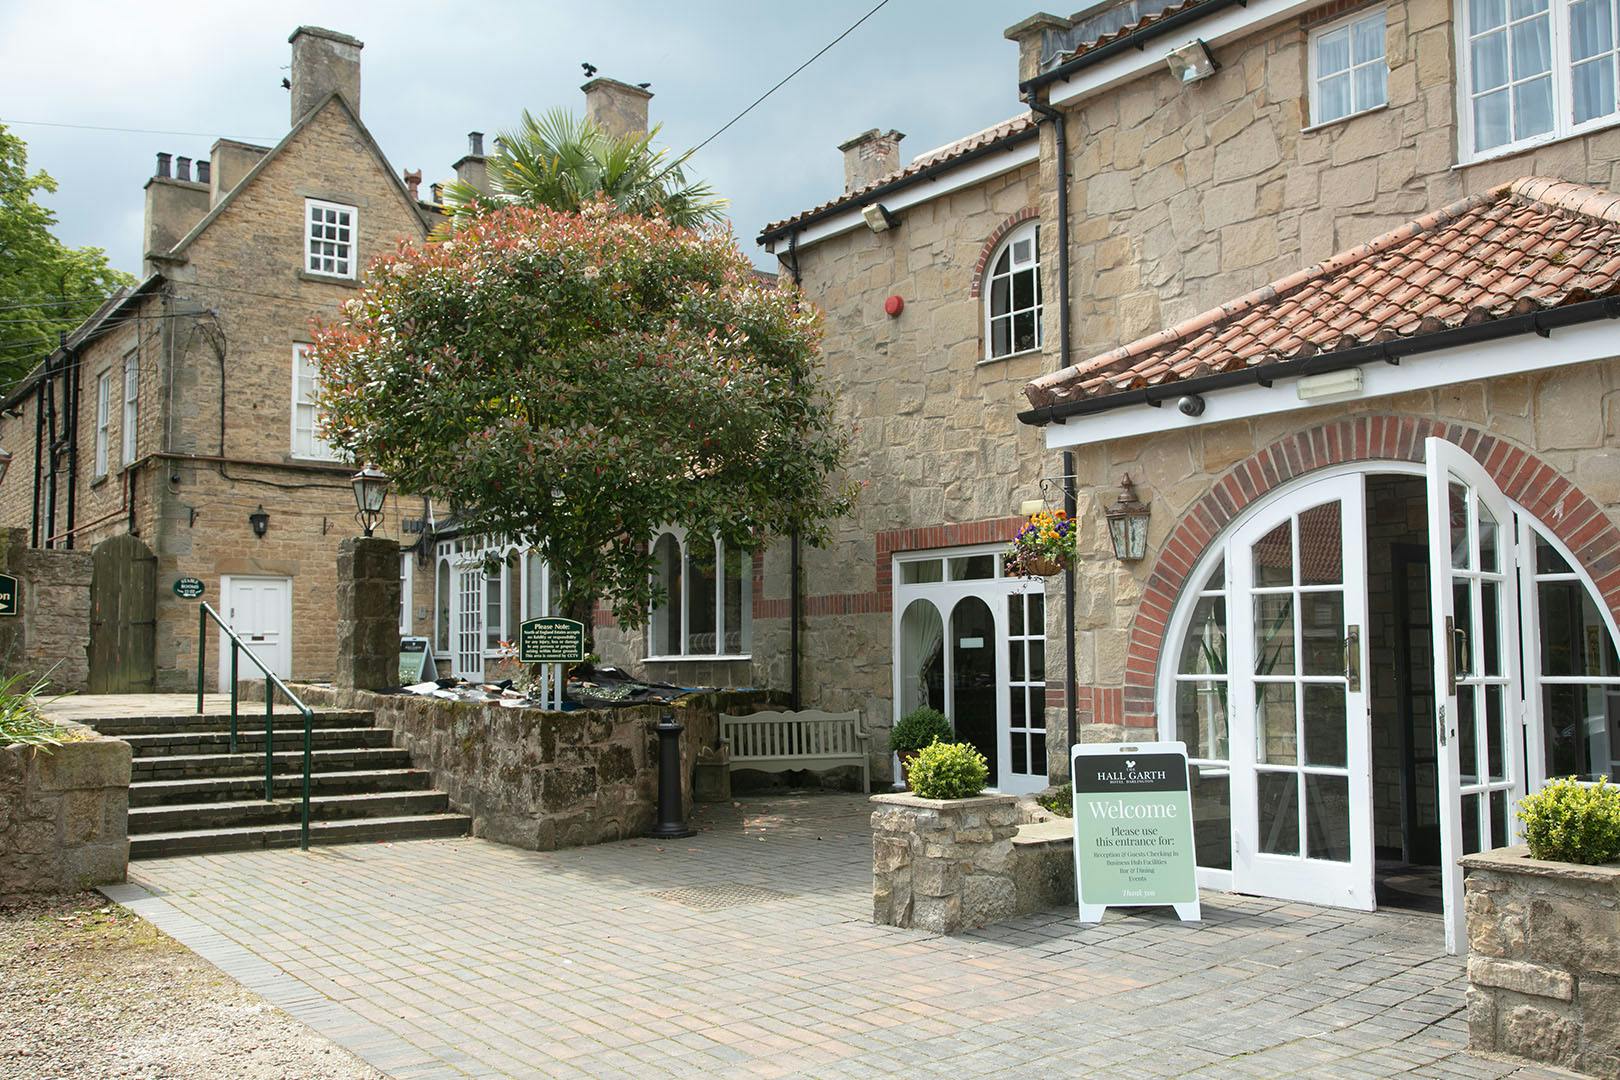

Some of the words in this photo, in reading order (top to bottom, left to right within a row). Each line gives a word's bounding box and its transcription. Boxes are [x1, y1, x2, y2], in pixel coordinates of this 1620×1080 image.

[1097, 772, 1126, 780] HALL
[1128, 771, 1166, 780] GARTH
[1088, 800, 1177, 819] Welcome
[1111, 827, 1140, 836] Please
[1096, 837, 1113, 846] this
[1115, 838, 1156, 846] entrance
[1159, 836, 1174, 845] for:
